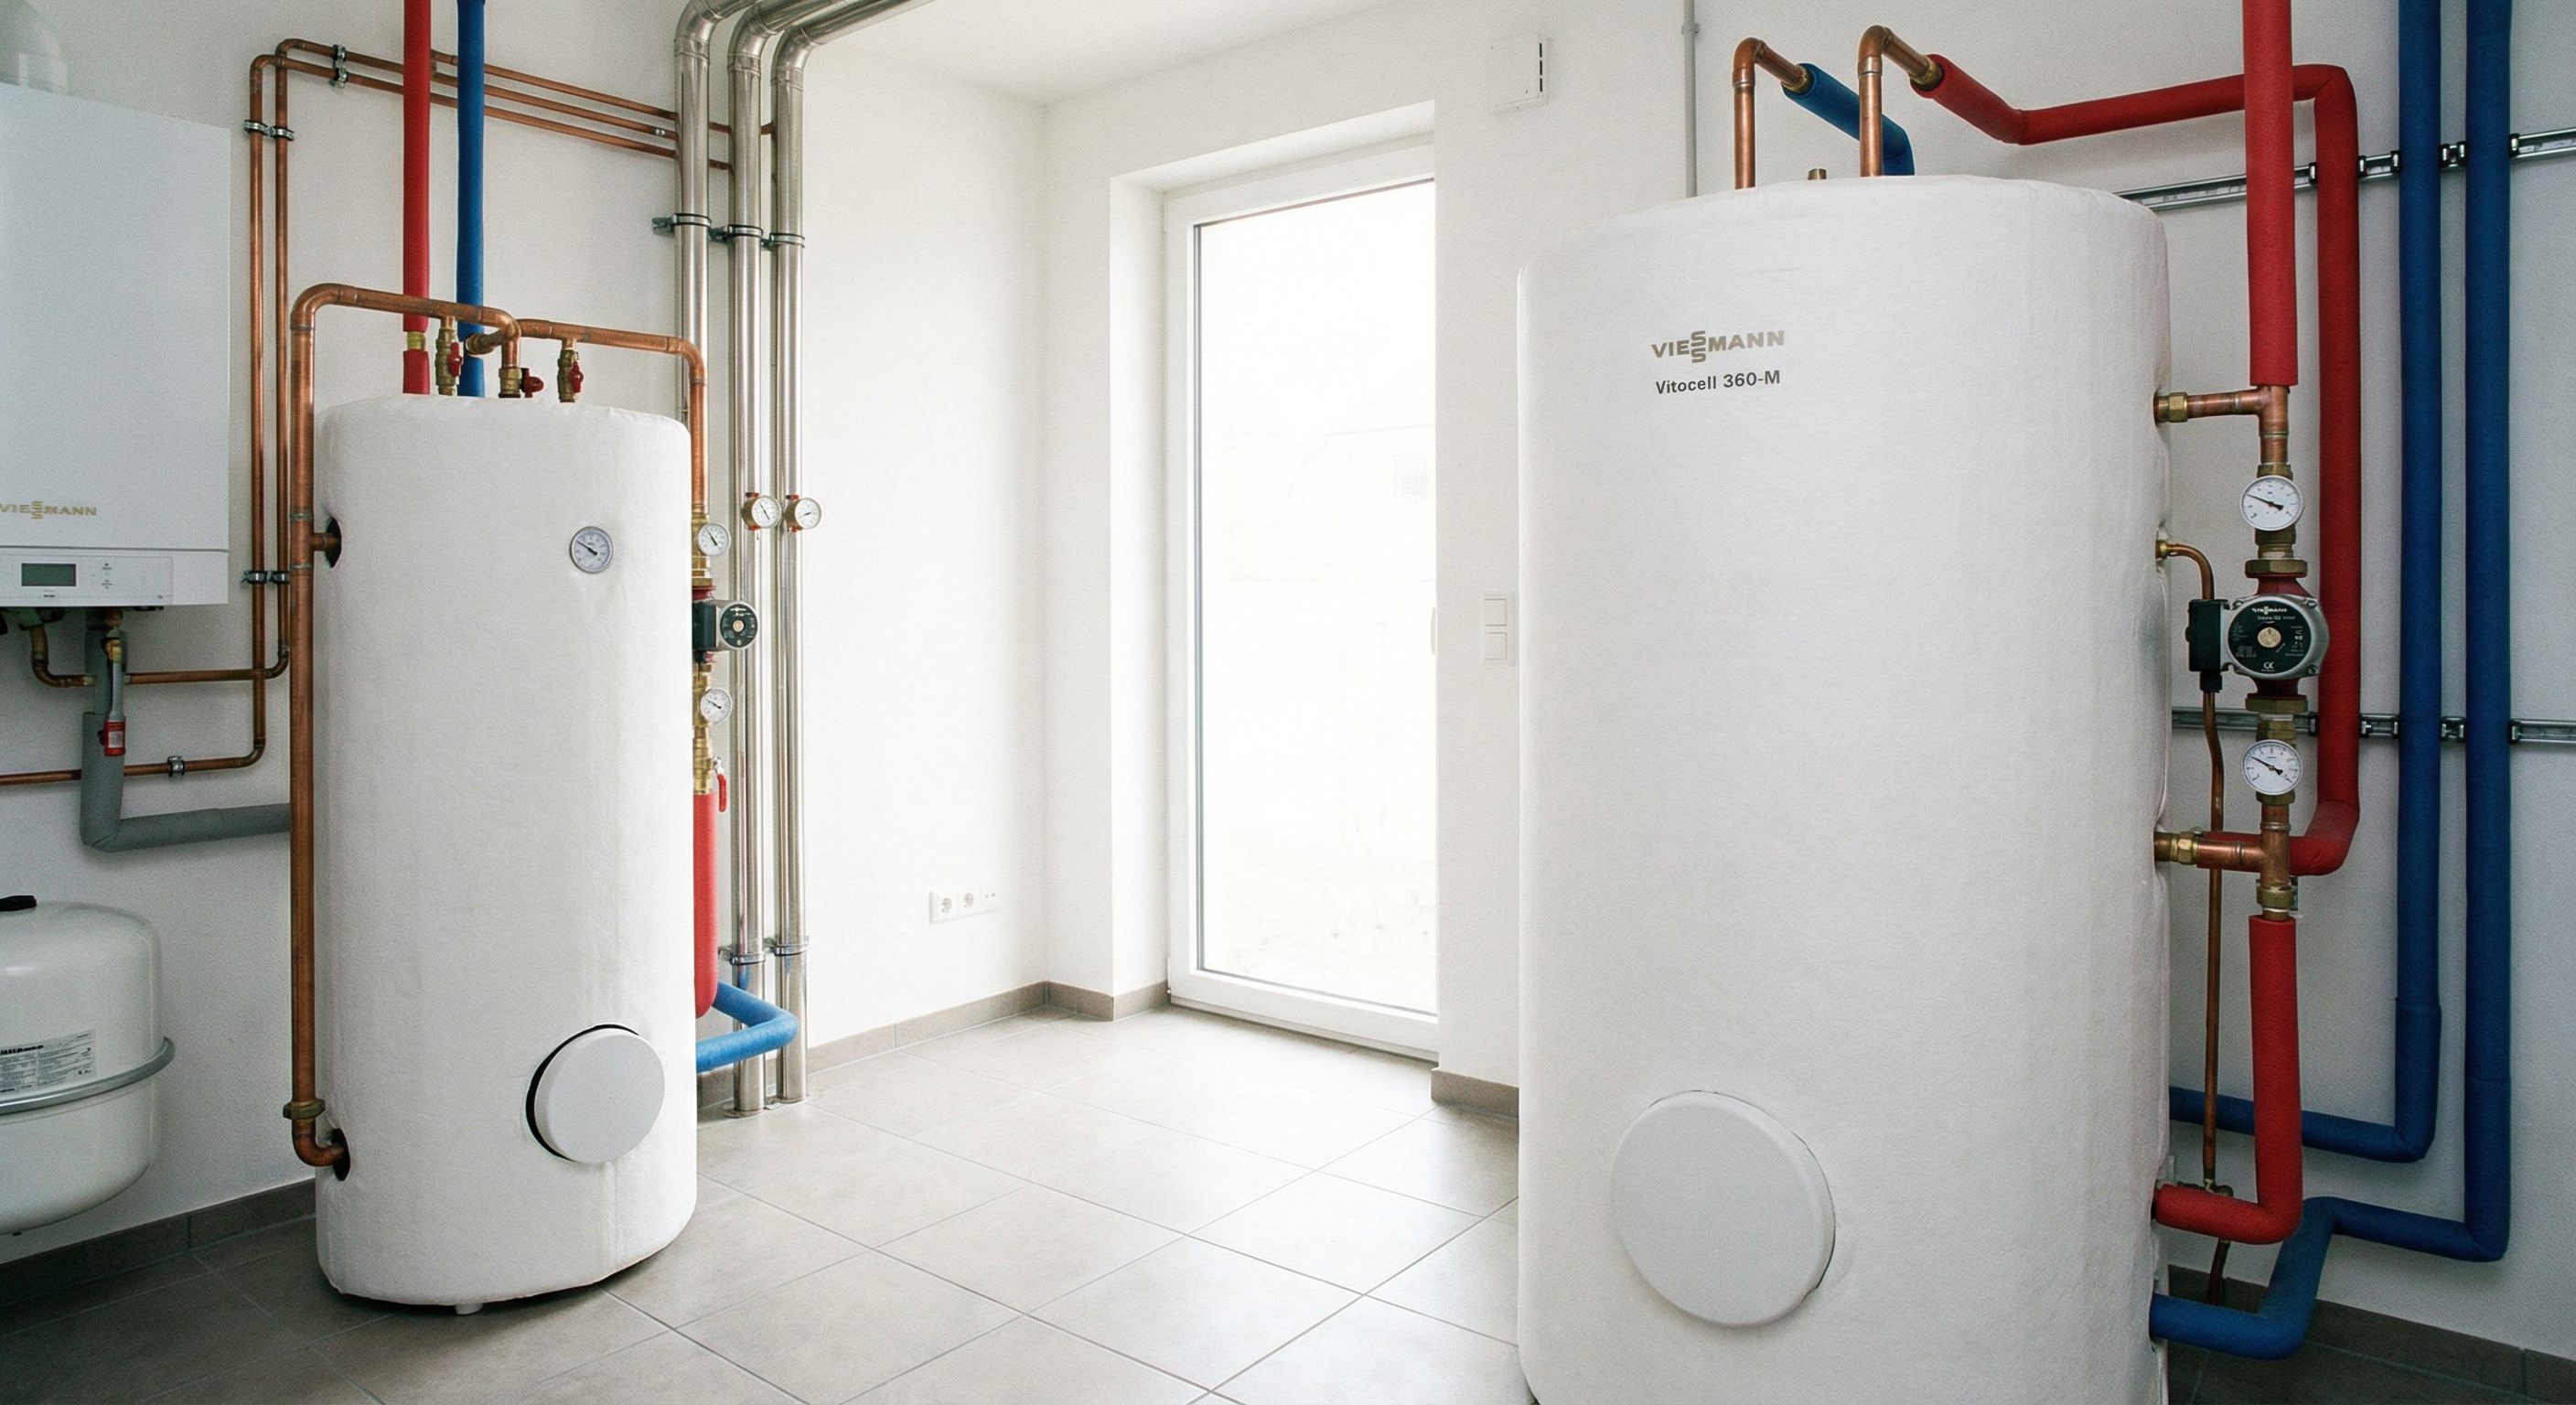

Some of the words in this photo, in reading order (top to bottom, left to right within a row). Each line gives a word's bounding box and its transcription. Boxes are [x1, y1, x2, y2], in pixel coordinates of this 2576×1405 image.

[1651, 330, 1784, 363] VIESSMANN
[1656, 376, 1716, 394] Vitocell
[1723, 370, 1780, 388] 360-M
